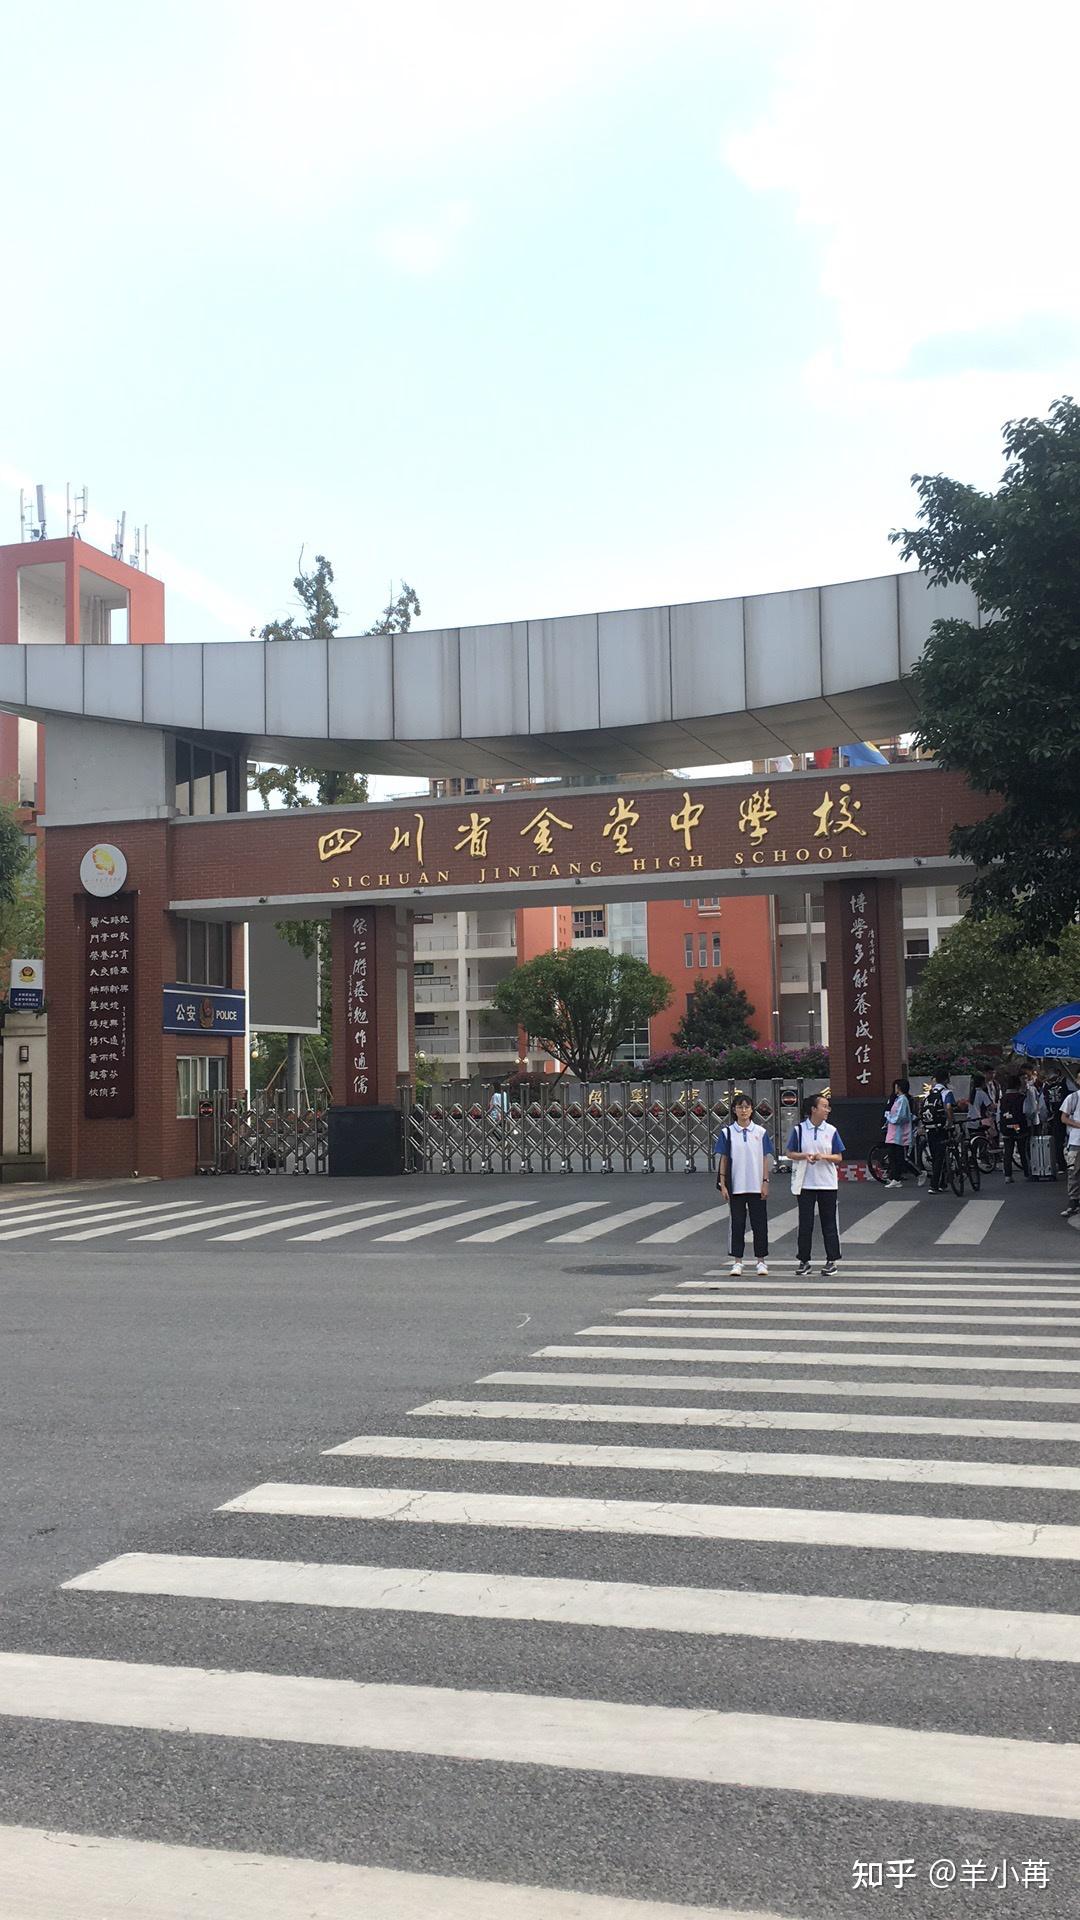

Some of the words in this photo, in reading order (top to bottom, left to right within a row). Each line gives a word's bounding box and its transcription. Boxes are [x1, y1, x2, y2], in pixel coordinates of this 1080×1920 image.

[331, 870, 450, 888] SICHUAN
[478, 861, 602, 884] JINTANG
[633, 855, 704, 871] HIGH
[735, 845, 852, 865] SCHOOL
[175, 1003, 196, 1022] 公安
[215, 1010, 237, 1021] POLICE
[1043, 1046, 1070, 1056] pepsi
